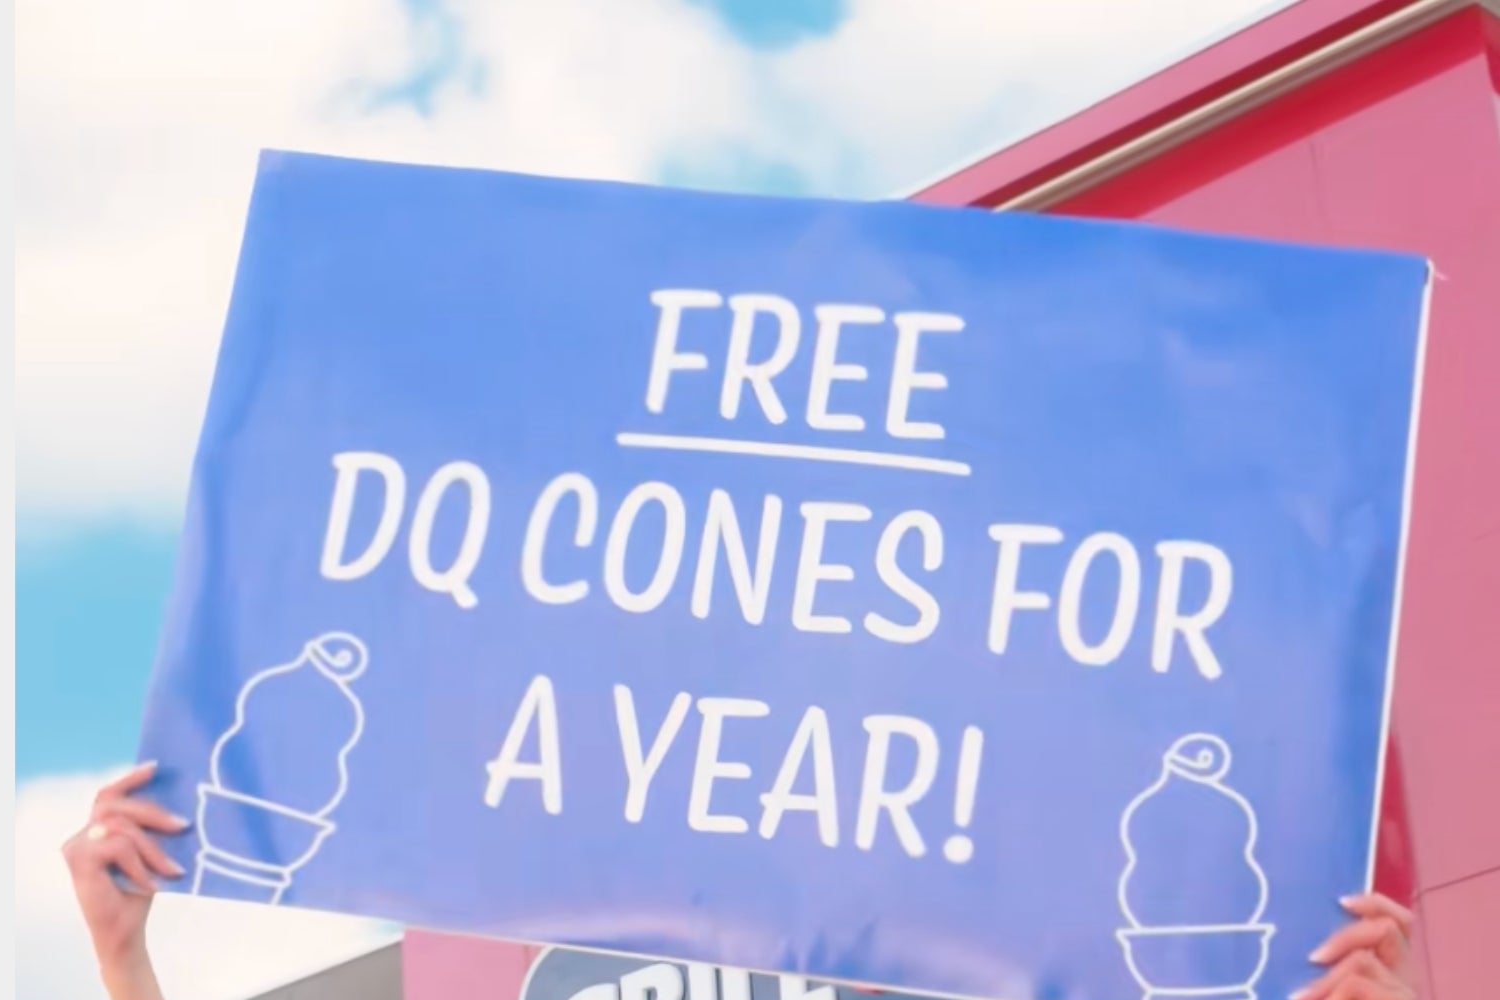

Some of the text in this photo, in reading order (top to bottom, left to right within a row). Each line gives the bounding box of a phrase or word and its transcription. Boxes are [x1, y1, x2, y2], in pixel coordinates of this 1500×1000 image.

[645, 288, 965, 440] FREE
[320, 451, 1233, 680] DQ CONES FOR
[484, 674, 985, 865] A YEAR!
